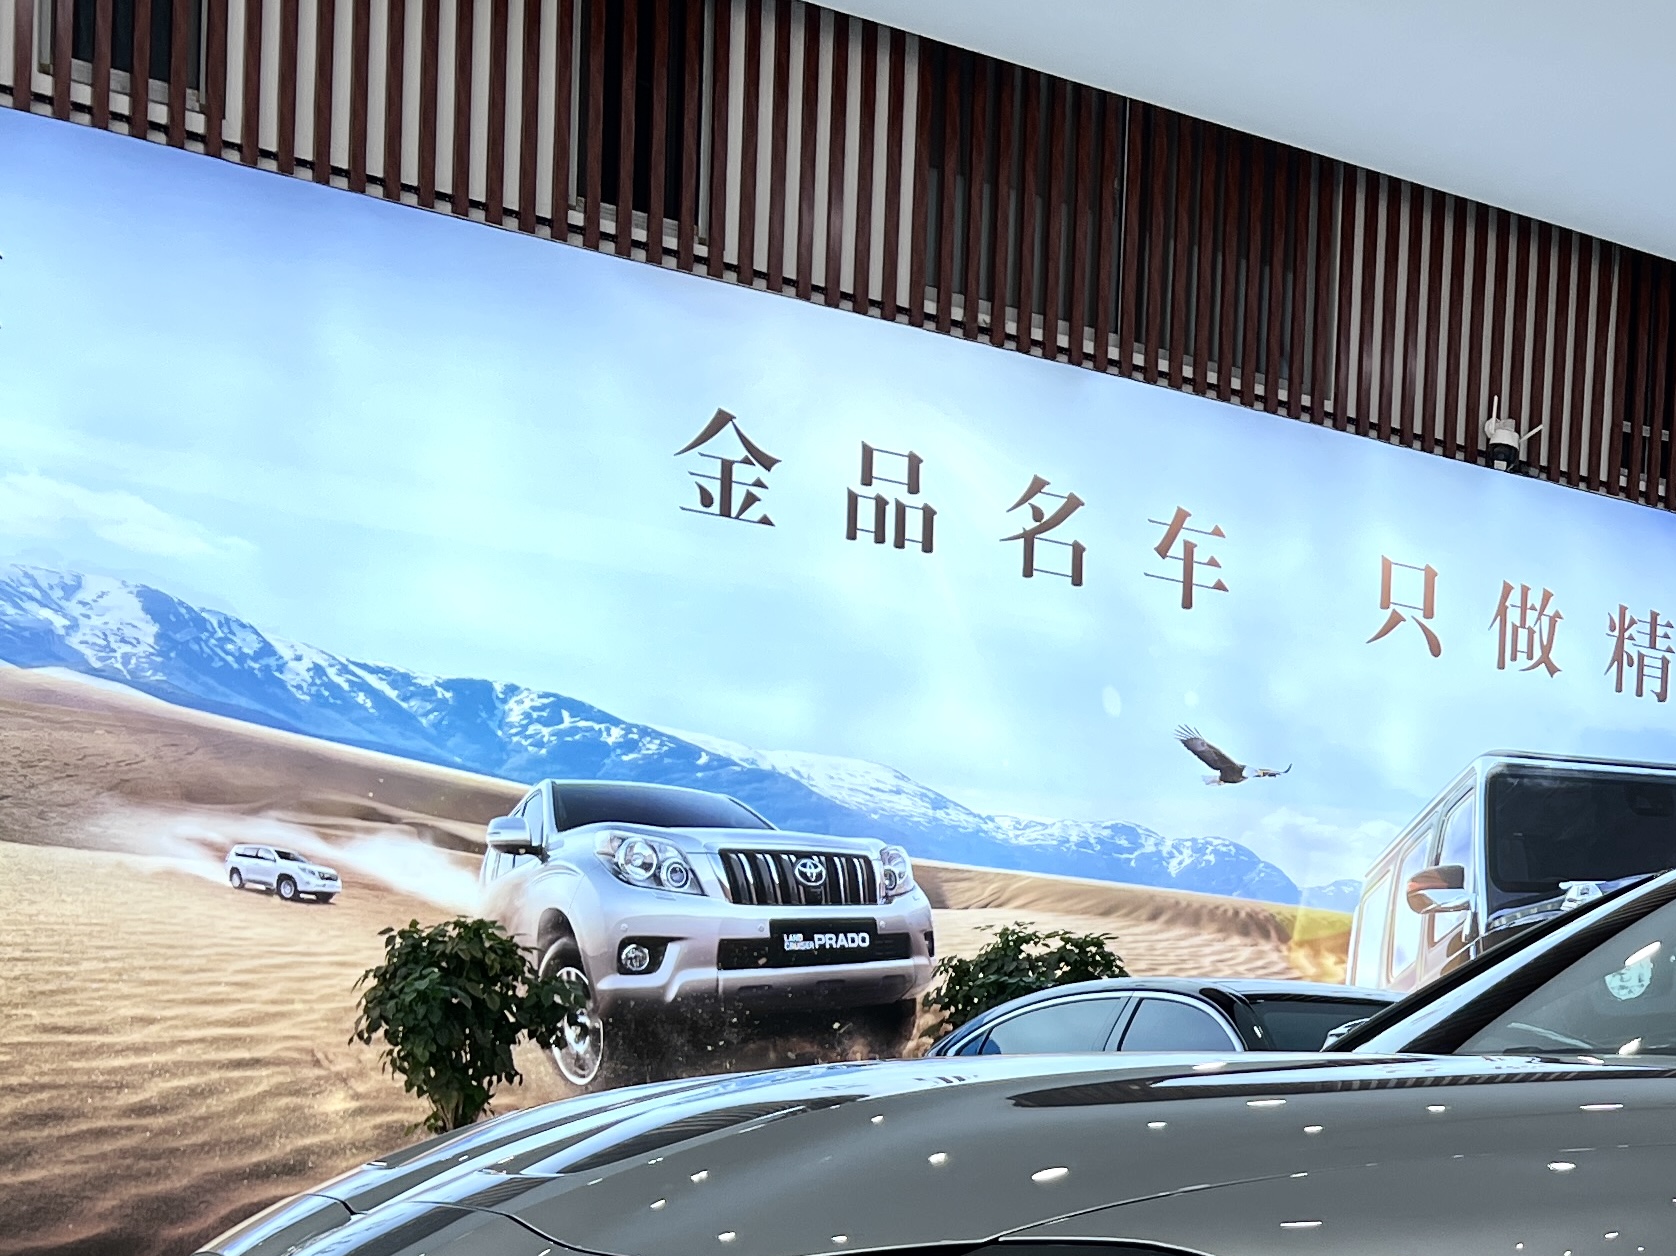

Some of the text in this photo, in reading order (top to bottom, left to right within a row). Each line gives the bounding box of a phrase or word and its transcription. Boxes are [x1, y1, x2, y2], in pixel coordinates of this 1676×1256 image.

[674, 407, 1229, 610] 金品名车
[814, 932, 870, 949] PRADO
